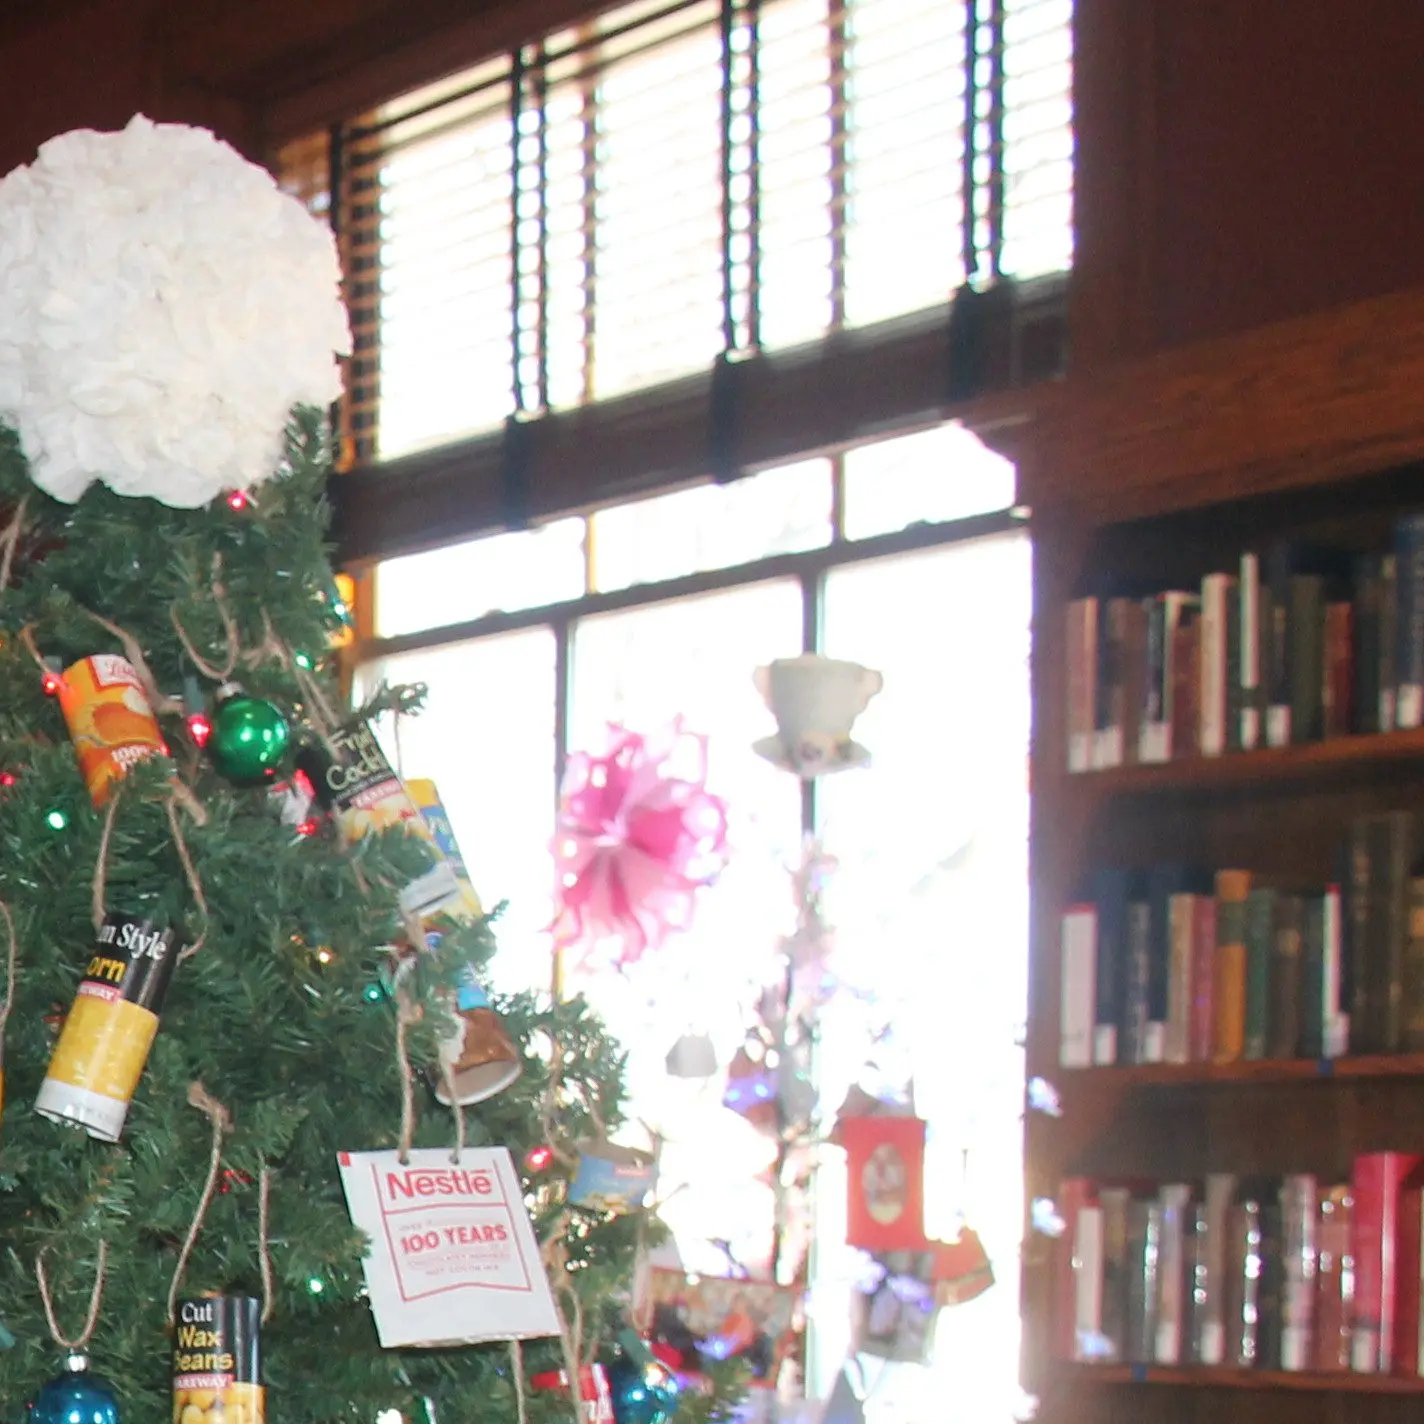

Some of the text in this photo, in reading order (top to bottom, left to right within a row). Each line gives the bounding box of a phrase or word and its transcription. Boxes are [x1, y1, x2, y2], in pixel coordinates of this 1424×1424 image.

[115, 921, 168, 961] Style
[400, 1230, 441, 1255] 100
[443, 1223, 508, 1245] YEARS
[181, 1302, 214, 1323] Cut
[177, 1326, 224, 1349] Wax
